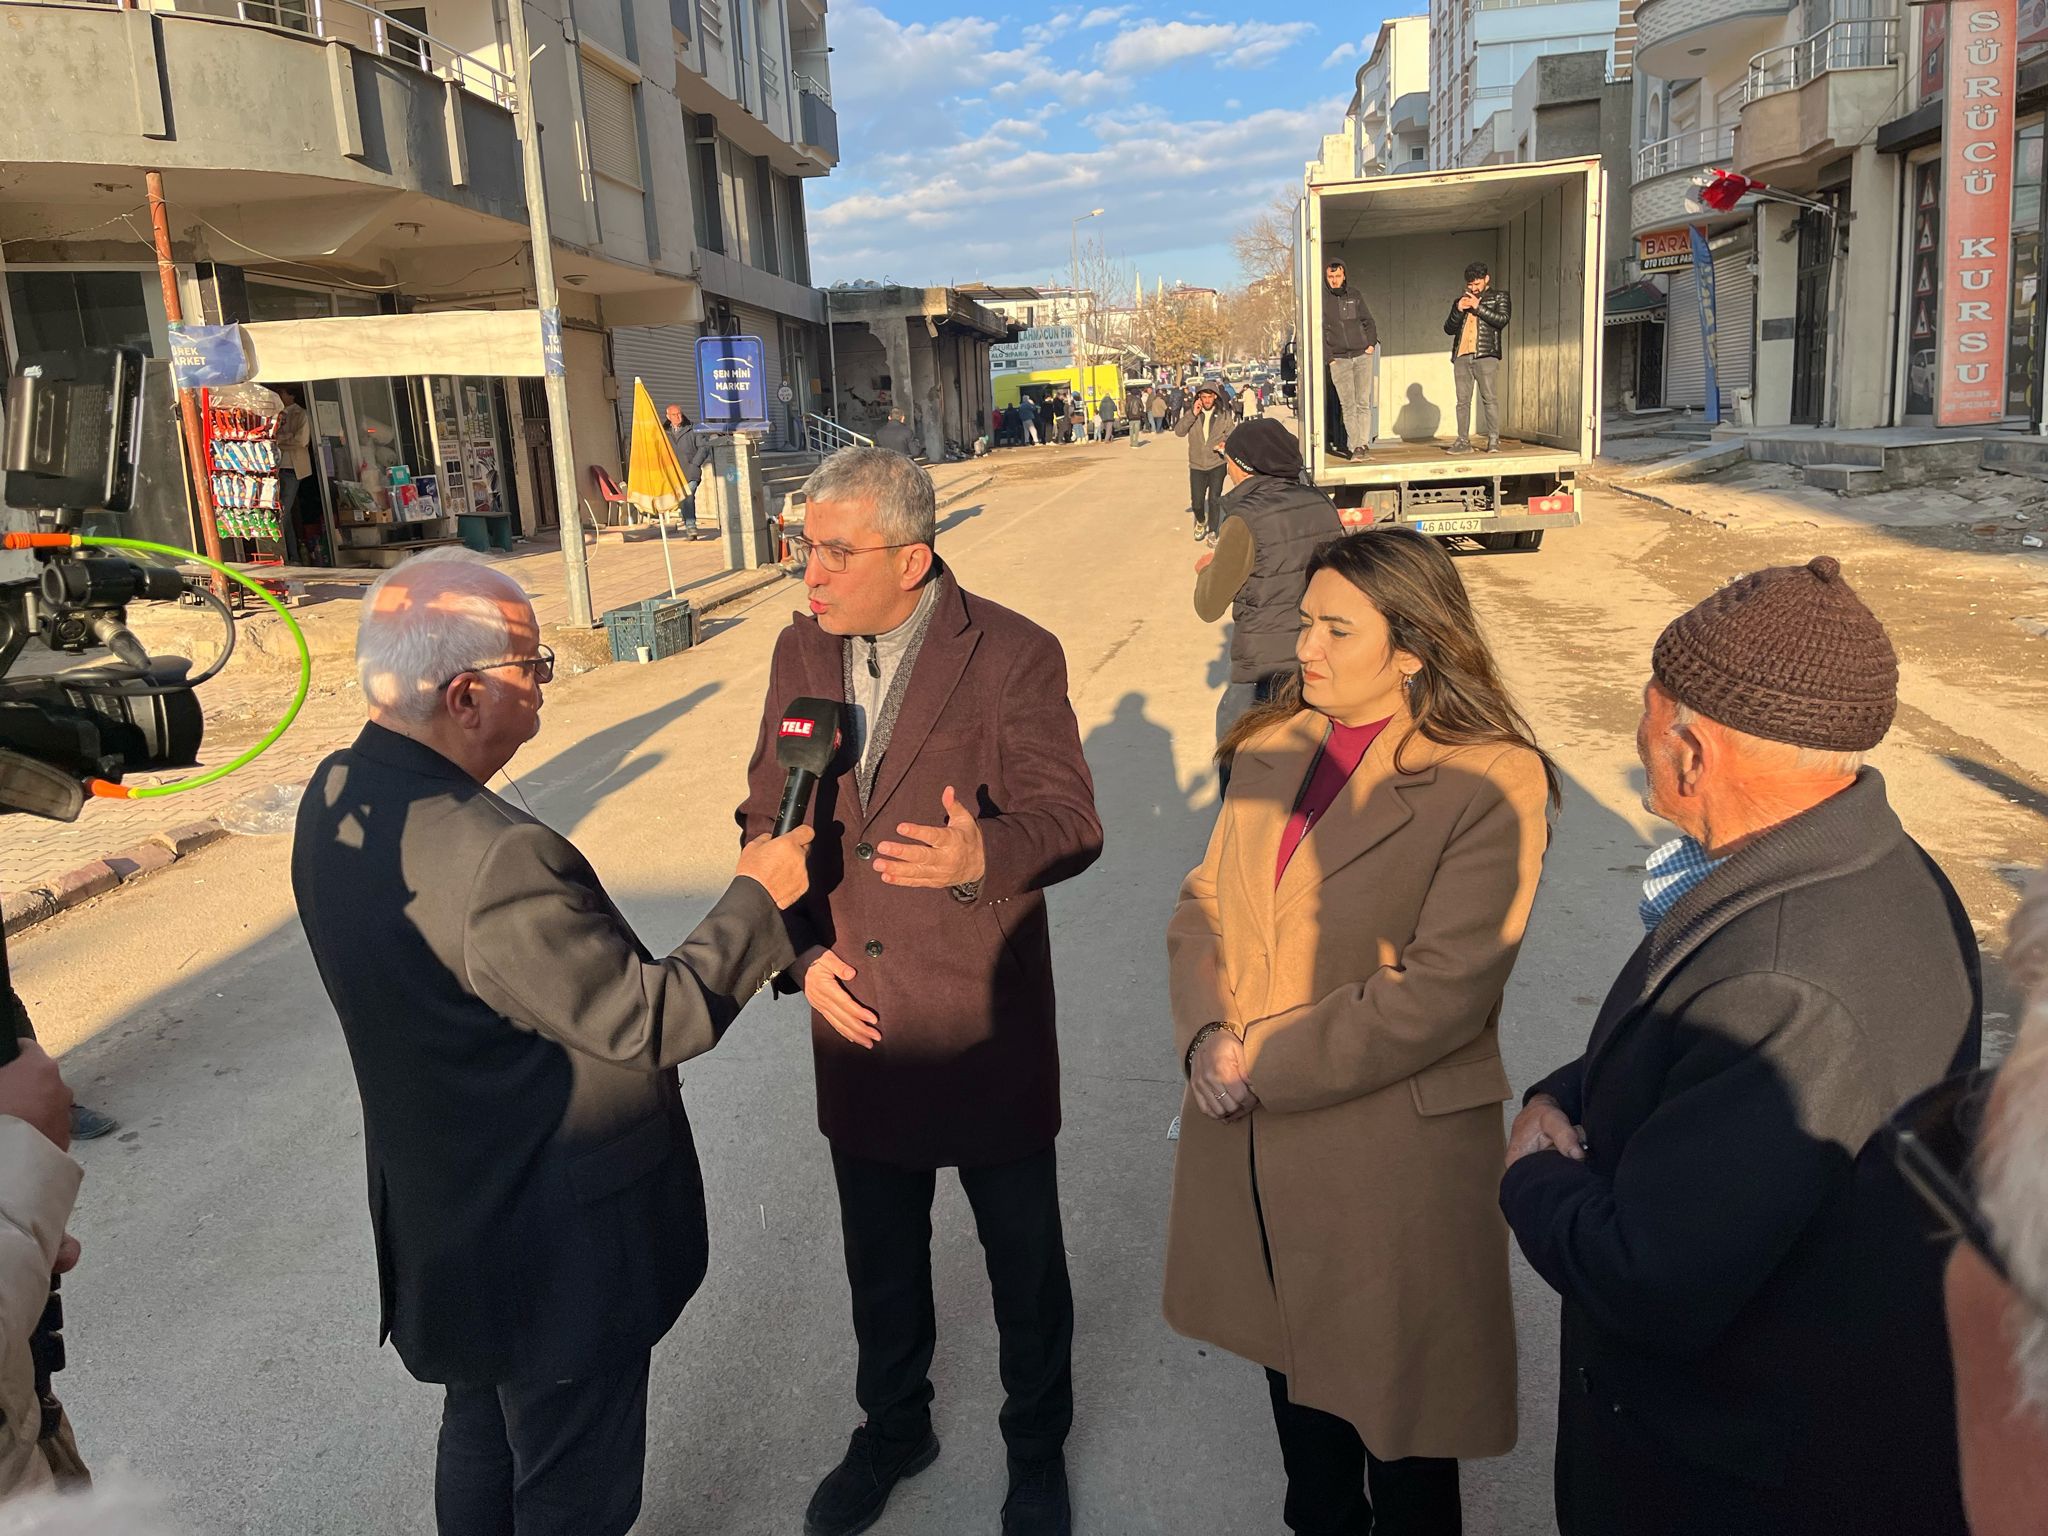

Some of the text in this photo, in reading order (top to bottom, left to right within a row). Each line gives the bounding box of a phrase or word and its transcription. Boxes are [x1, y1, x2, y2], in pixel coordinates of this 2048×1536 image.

[1962, 11, 2002, 196] SÜRÜCÜ
[1646, 234, 1692, 255] BARA
[1644, 259, 1657, 268] OTO
[1658, 255, 1680, 267] YEDEK
[1955, 237, 1997, 384] KURSU
[174, 356, 206, 366] ARKET
[713, 367, 751, 380] ŞEN MİNİ
[715, 382, 750, 391] MARKET
[1422, 520, 1479, 532] 46 ADC 437
[781, 721, 812, 734] TELE
